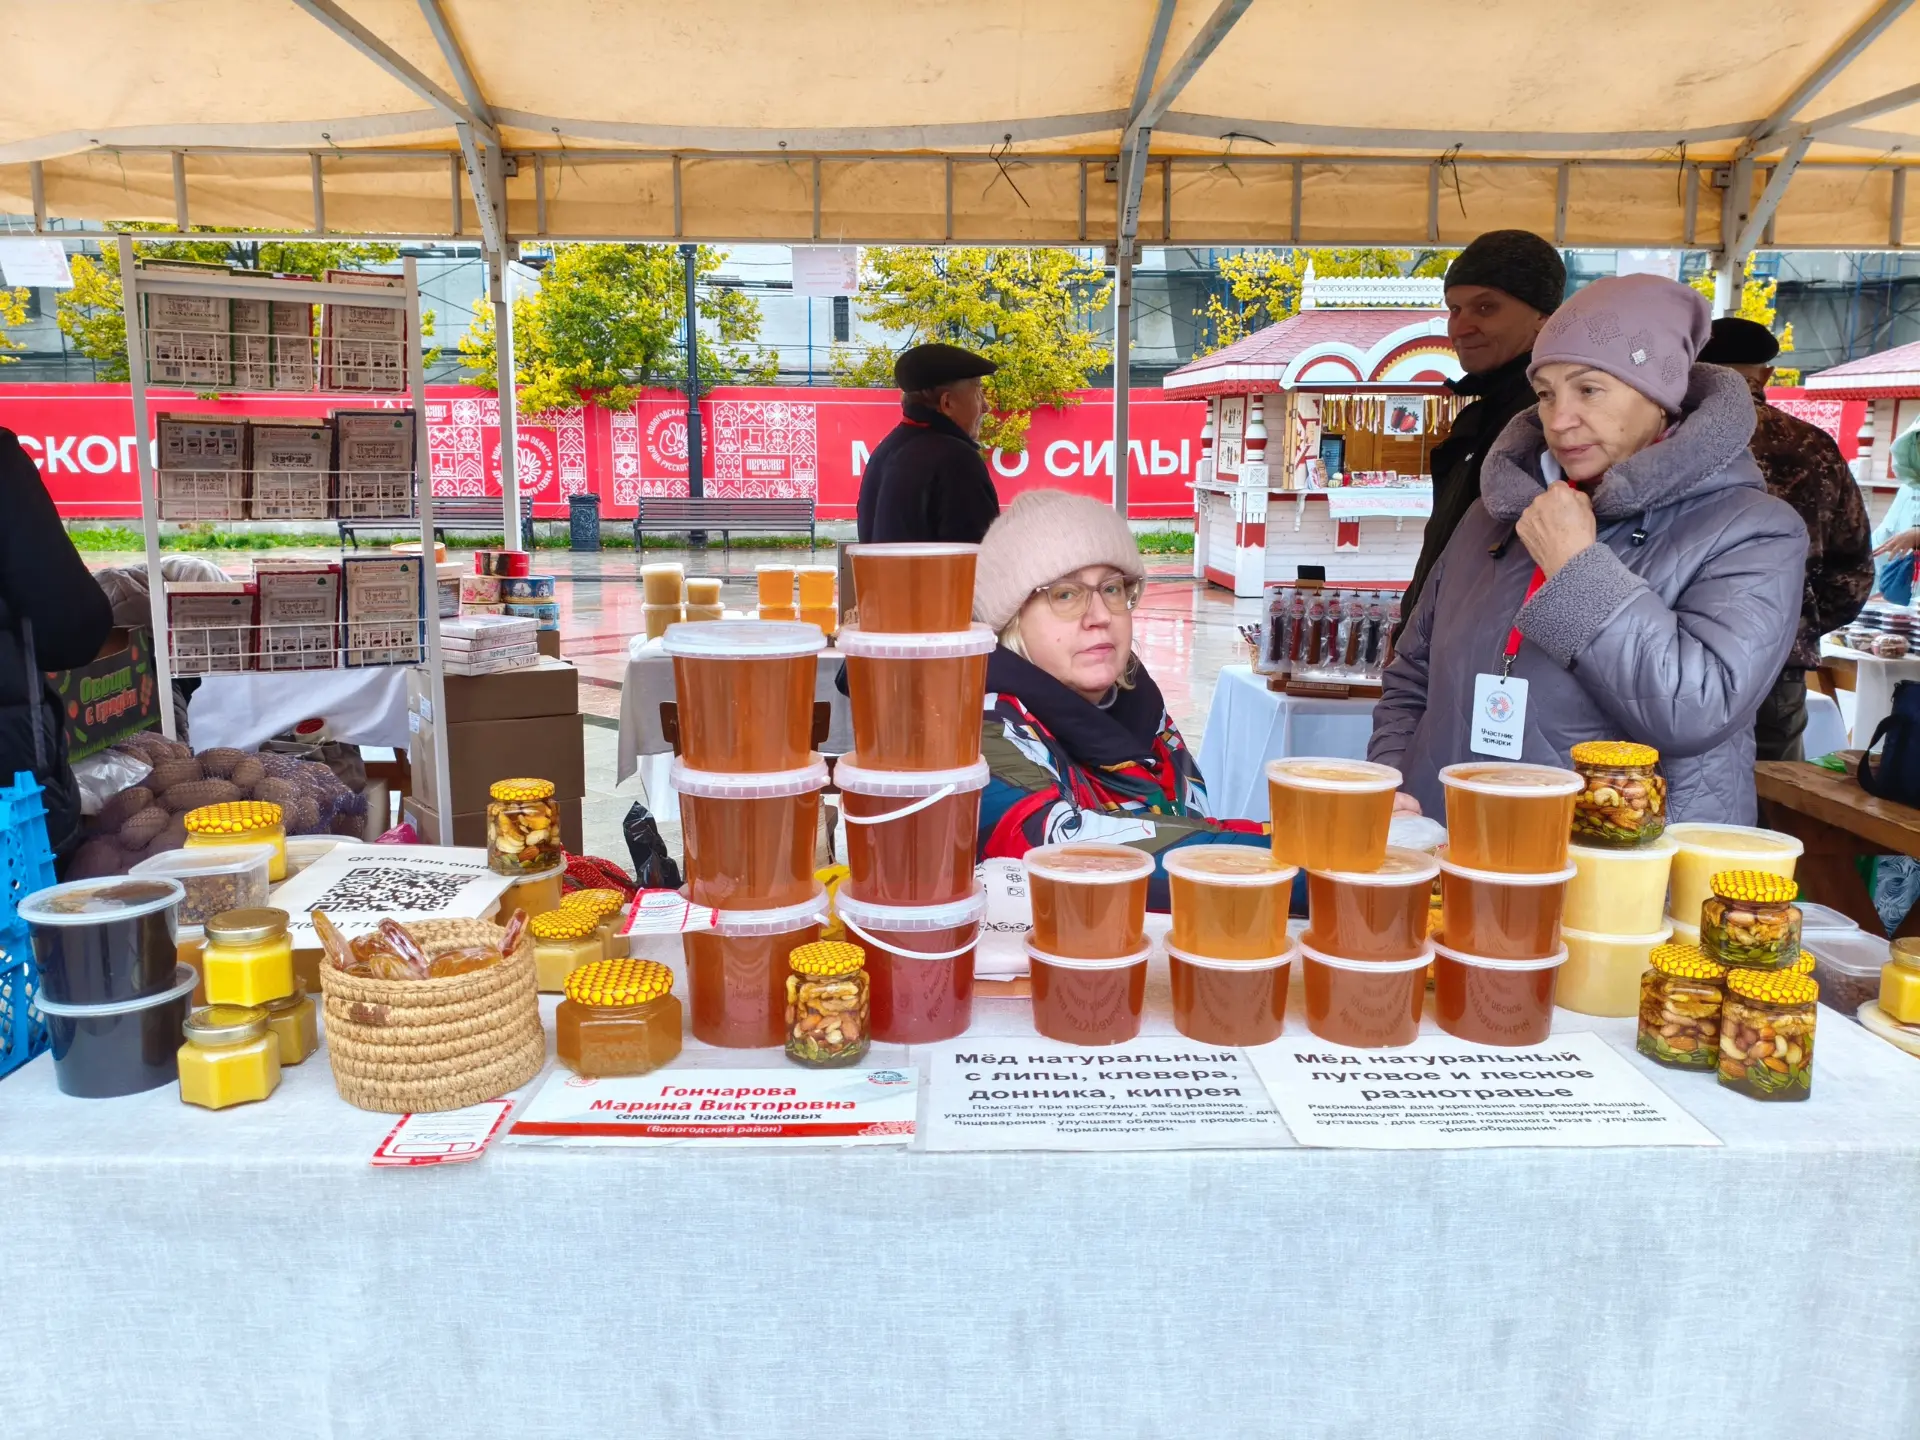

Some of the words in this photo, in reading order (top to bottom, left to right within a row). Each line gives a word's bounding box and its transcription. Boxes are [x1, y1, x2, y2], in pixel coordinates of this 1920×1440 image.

[647, 408, 685, 435] ВОЛОГОДСКАЯ
[530, 435, 553, 461] ОБЛАСТЬ
[536, 469, 554, 491] СЕВЕРА
[1481, 727, 1514, 740] Участник
[1482, 737, 1512, 747] ярмарки
[449, 862, 489, 870] опла
[955, 1053, 1018, 1065] Мёд
[1028, 1051, 1238, 1065] натуральный
[1294, 1053, 1362, 1065] Мёд
[1368, 1051, 1582, 1065] натуральный
[965, 1072, 982, 1081] с
[991, 1071, 1088, 1082] липы,
[1099, 1069, 1238, 1081] клевера,
[1312, 1071, 1441, 1083] луговое
[1450, 1071, 1471, 1080] и
[1480, 1069, 1595, 1079] лесное
[660, 1085, 797, 1098] Гончарова
[968, 1088, 1116, 1101] донника,
[1126, 1087, 1242, 1100] кипрея
[1360, 1088, 1574, 1101] разнотравье
[589, 1099, 692, 1112] Марина
[699, 1099, 856, 1112] Викторовна
[615, 1112, 690, 1121] семейная
[694, 1113, 747, 1122] пасека
[750, 1112, 822, 1121] Чижовых
[944, 1111, 1012, 1119] укрепляет
[1057, 1118, 1123, 1126] улучшает
[646, 1124, 734, 1135] (Вологодский
[736, 1124, 782, 1134] район)
